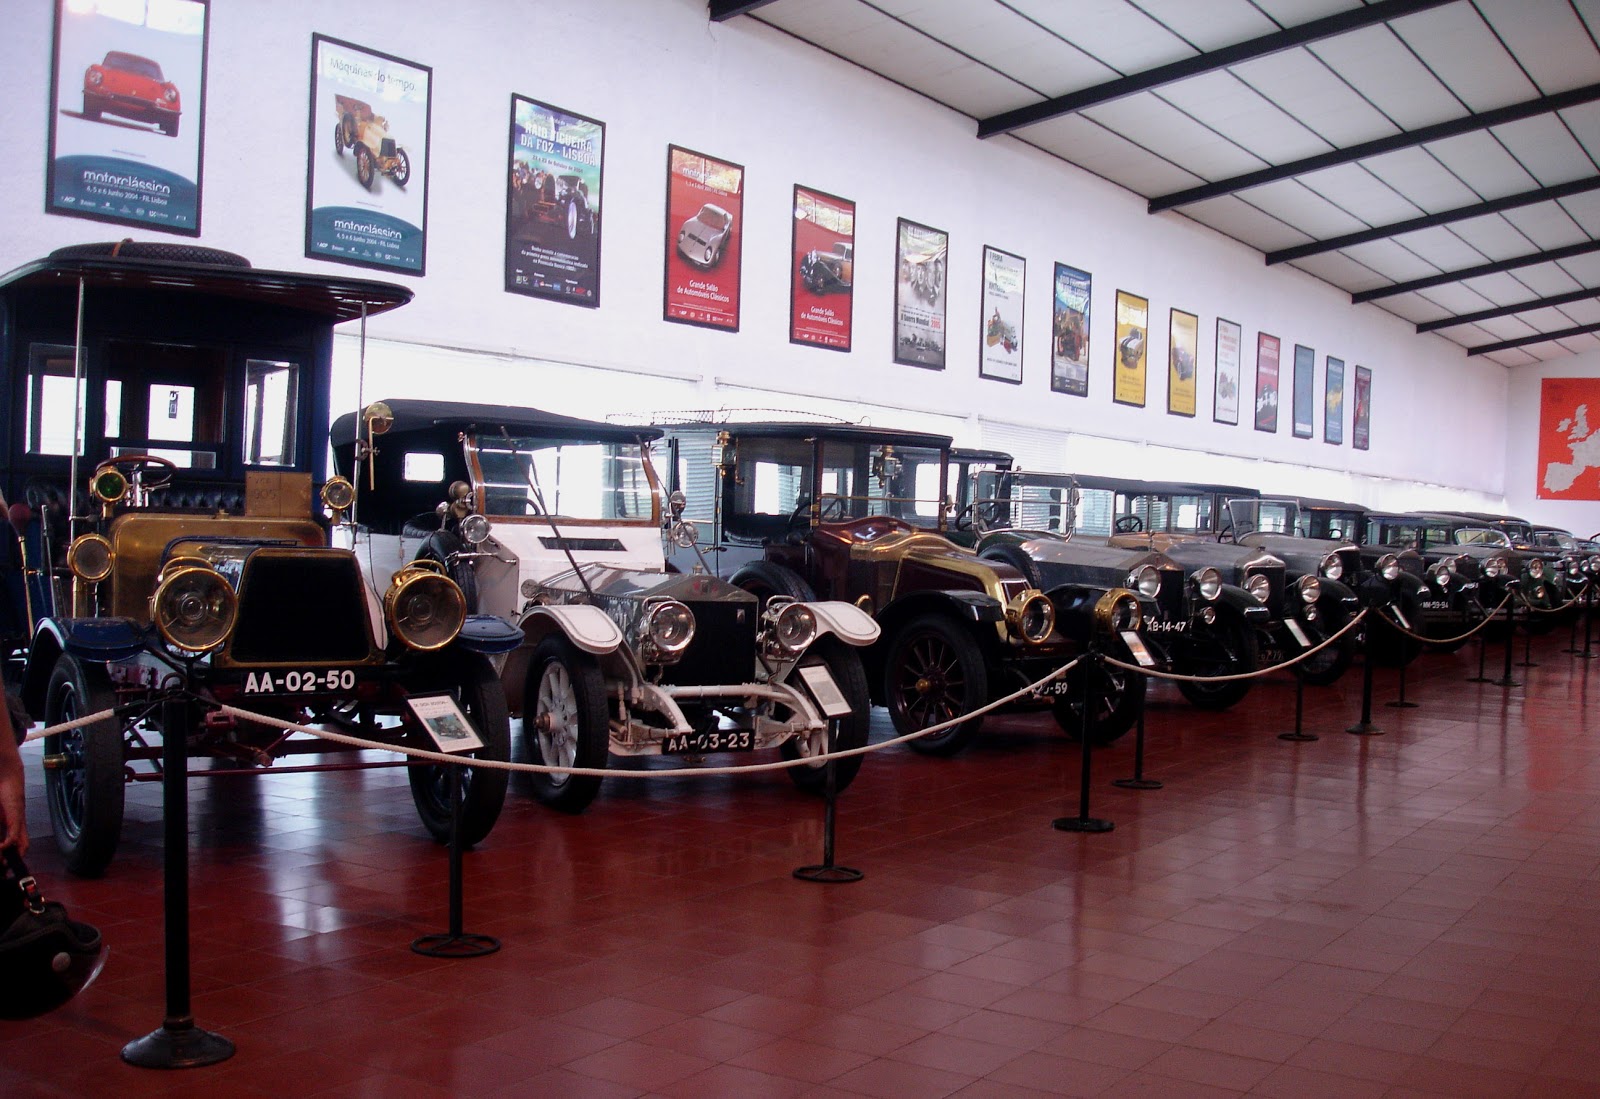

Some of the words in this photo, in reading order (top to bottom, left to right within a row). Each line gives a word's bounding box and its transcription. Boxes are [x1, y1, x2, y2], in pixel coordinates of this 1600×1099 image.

[520, 133, 533, 148] DA
[536, 138, 555, 154] FOZ
[562, 146, 597, 167] LISBOA
[83, 171, 171, 194] motorclássico
[334, 219, 402, 239] motorclássico
[676, 285, 684, 294] de
[684, 287, 710, 299] Automóveis
[710, 292, 730, 303] Clássicos
[689, 279, 706, 290] Grande
[706, 283, 719, 292] Salão
[1147, 620, 1187, 632] AB-14-47
[244, 669, 356, 693] AA-02-50
[667, 732, 750, 752] AA-03-23
